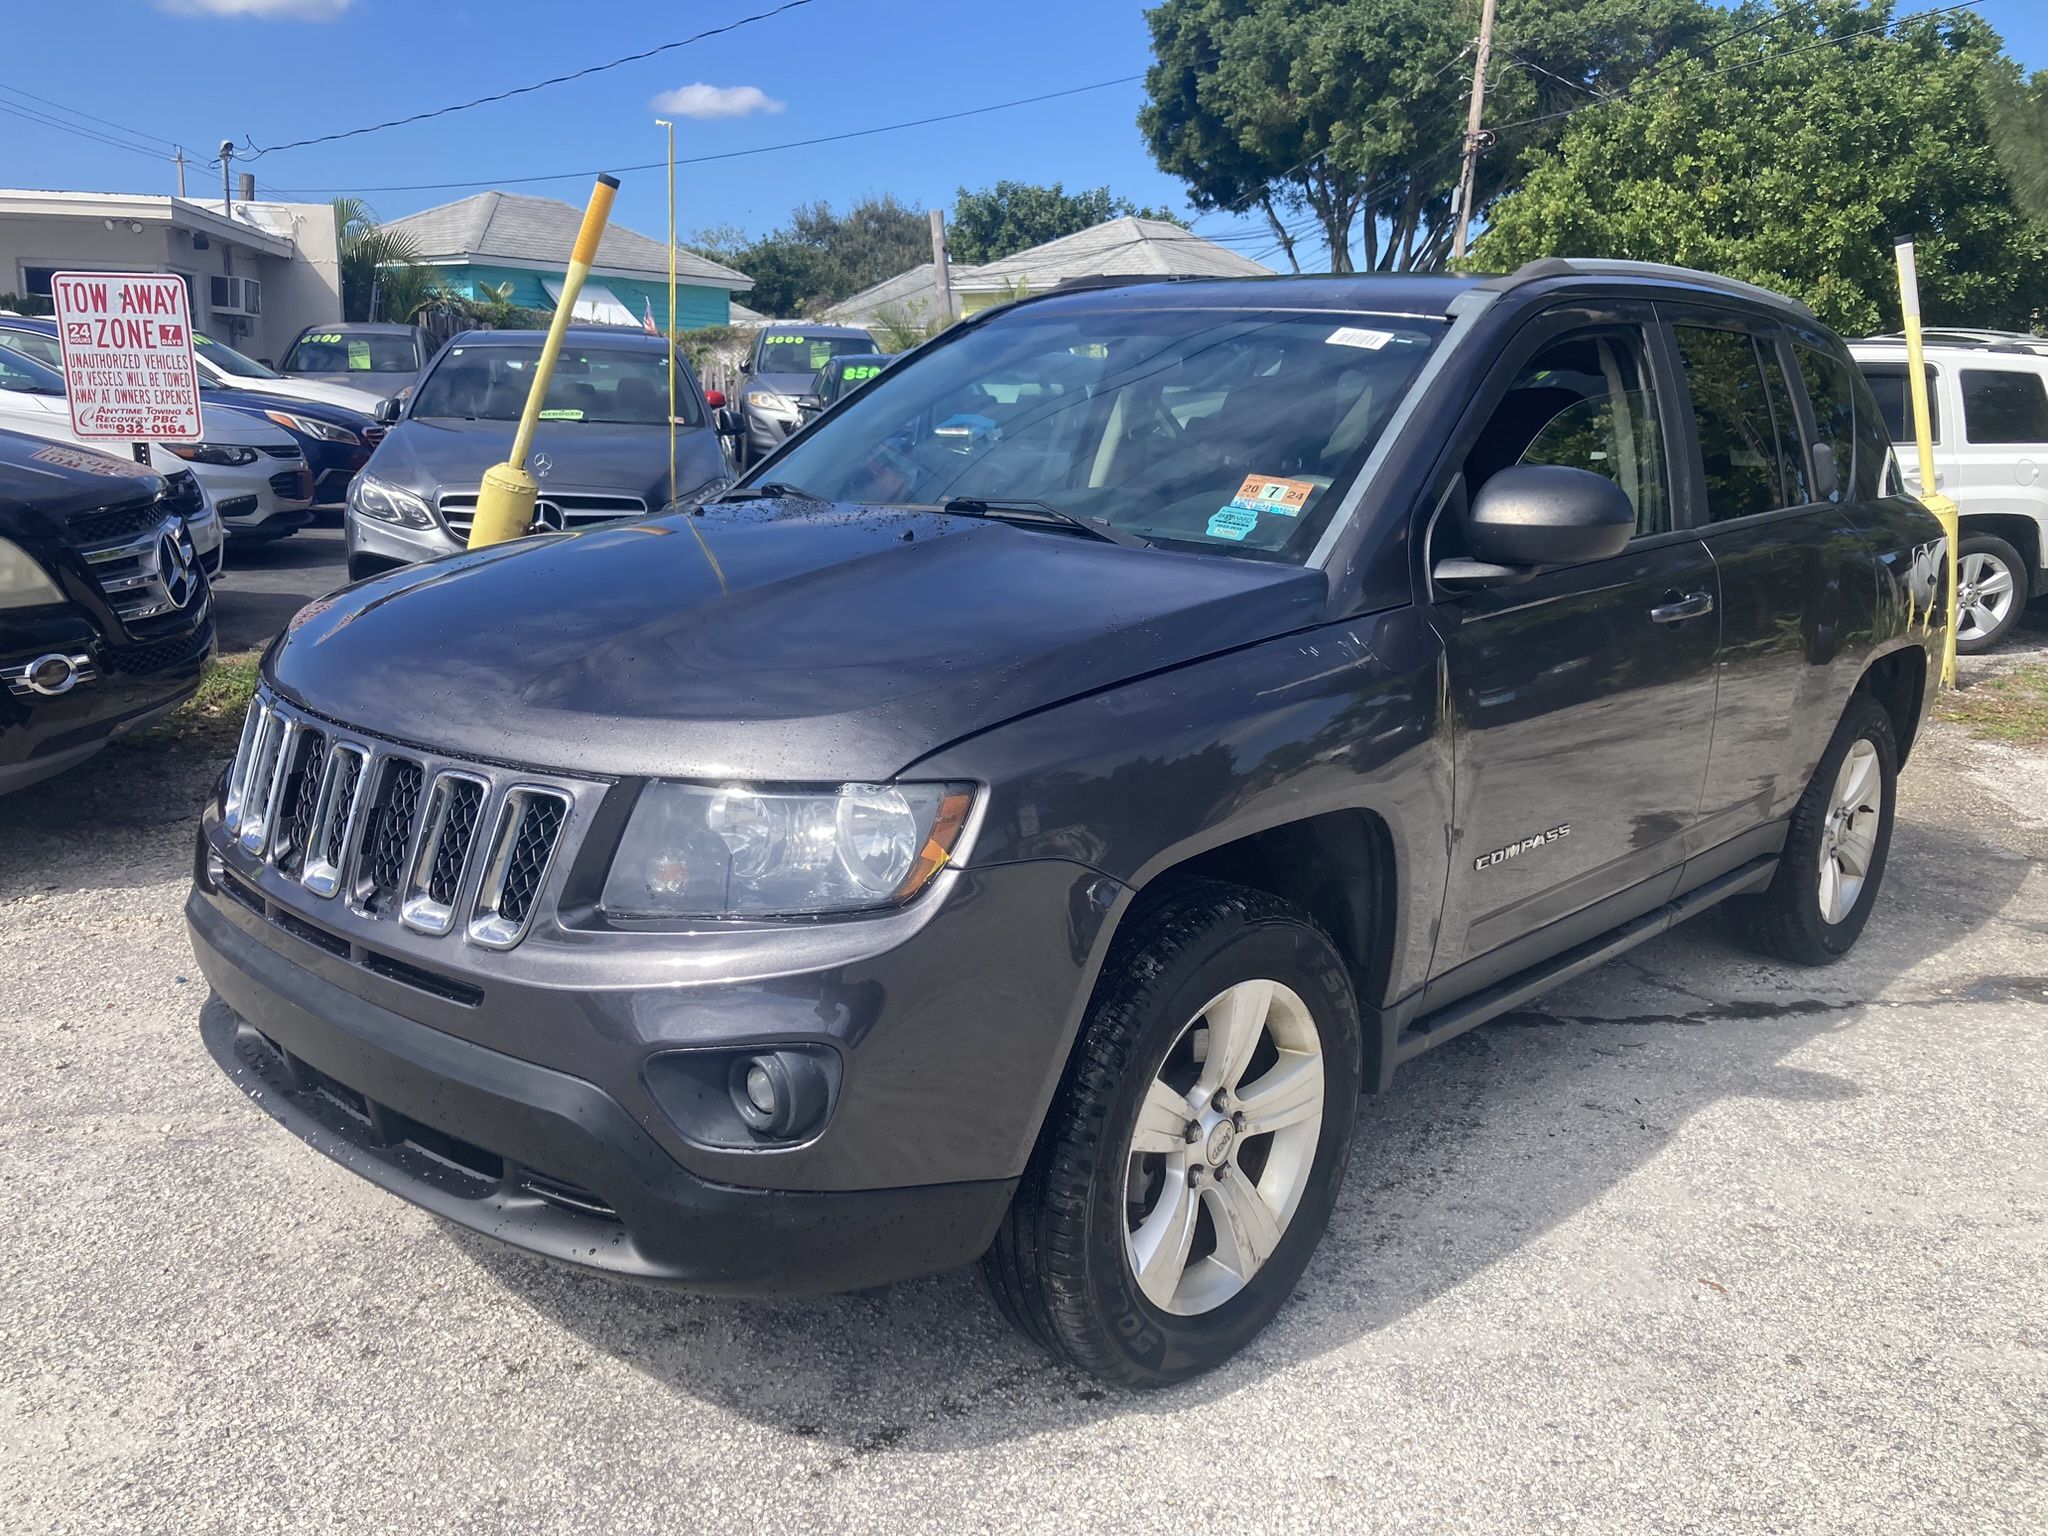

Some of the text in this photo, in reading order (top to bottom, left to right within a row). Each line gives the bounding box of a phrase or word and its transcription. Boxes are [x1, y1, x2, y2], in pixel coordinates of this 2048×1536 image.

[60, 283, 178, 315] TOW AWAY
[69, 324, 91, 338] 24
[95, 319, 157, 349] ZONE
[165, 326, 175, 338] 7
[765, 336, 805, 344] 5000
[69, 353, 188, 370] UNAUTHORIZED VEHICLES
[72, 370, 191, 387] OR VESSELS WILL BE TOWED
[75, 389, 193, 405] AWAY AT OWNERS EXPENSE
[97, 406, 194, 415] ANYTIME TOWING &
[95, 415, 178, 424] RECOVERY PBC
[1243, 485, 1304, 500] 20 7 24
[1474, 823, 1571, 871] COMPASS
